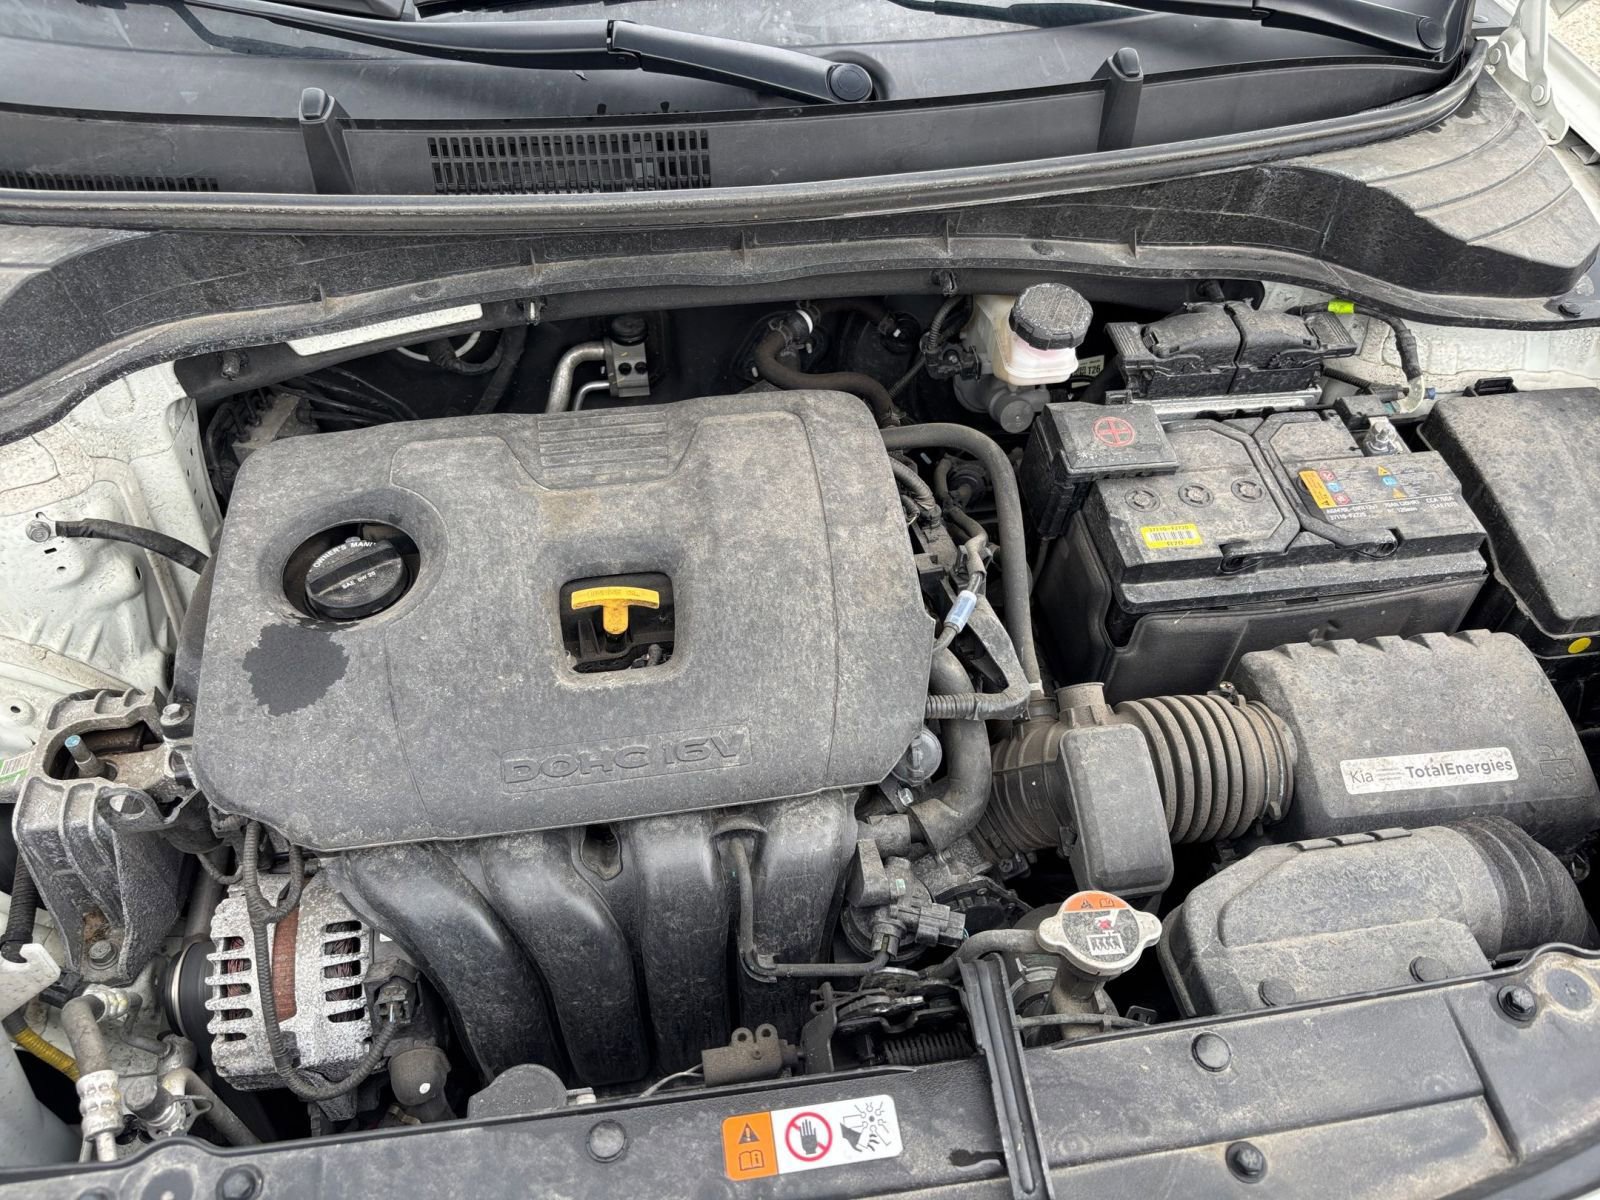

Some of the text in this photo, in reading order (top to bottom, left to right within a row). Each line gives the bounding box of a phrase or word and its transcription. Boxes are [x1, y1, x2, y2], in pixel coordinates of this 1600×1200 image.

[503, 734, 744, 783] DOHC 16V
[1350, 771, 1374, 784] Kia
[1405, 759, 1513, 778] TotalEnergies
